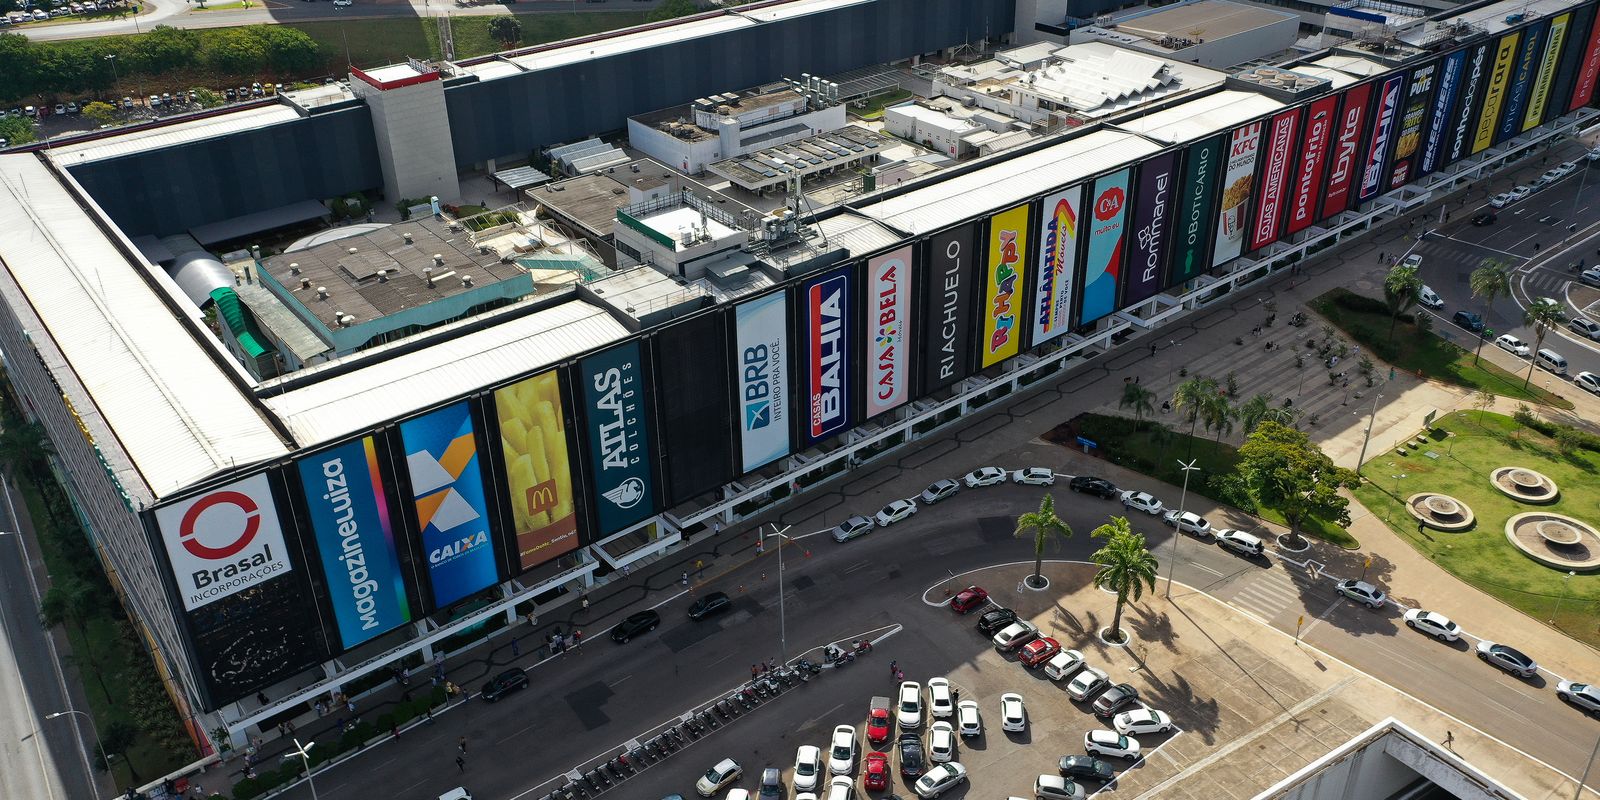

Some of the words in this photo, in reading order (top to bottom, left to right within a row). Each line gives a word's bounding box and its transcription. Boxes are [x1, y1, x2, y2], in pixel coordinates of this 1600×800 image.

[1520, 31, 1538, 80] CAROL
[1532, 28, 1562, 116] PERNAMBUCANAS
[1231, 136, 1258, 158] KFC
[1330, 106, 1360, 186] ibyte
[1366, 85, 1398, 188] BAHIA
[1422, 57, 1455, 172] SKECHERS
[1260, 202, 1274, 242] LOJAS
[1268, 117, 1290, 198] AMERICANAS
[1296, 122, 1322, 220] pontofrio
[1142, 172, 1168, 282] Rommanel
[880, 266, 896, 326] BELA
[940, 240, 960, 380] RIACHUELO
[1040, 216, 1058, 324] ATLÂNTIDA
[744, 344, 770, 402] BRB
[820, 288, 841, 423] BAHIA
[878, 345, 894, 400] CASA
[594, 368, 628, 470] ATLAS
[622, 362, 640, 464] COLCHÕES
[773, 386, 782, 422] INTEIRO
[812, 392, 820, 426] CASAS
[190, 561, 284, 604] INCORPORAÇÕES
[192, 544, 272, 590] Brasal
[430, 530, 488, 564] CAIXA
